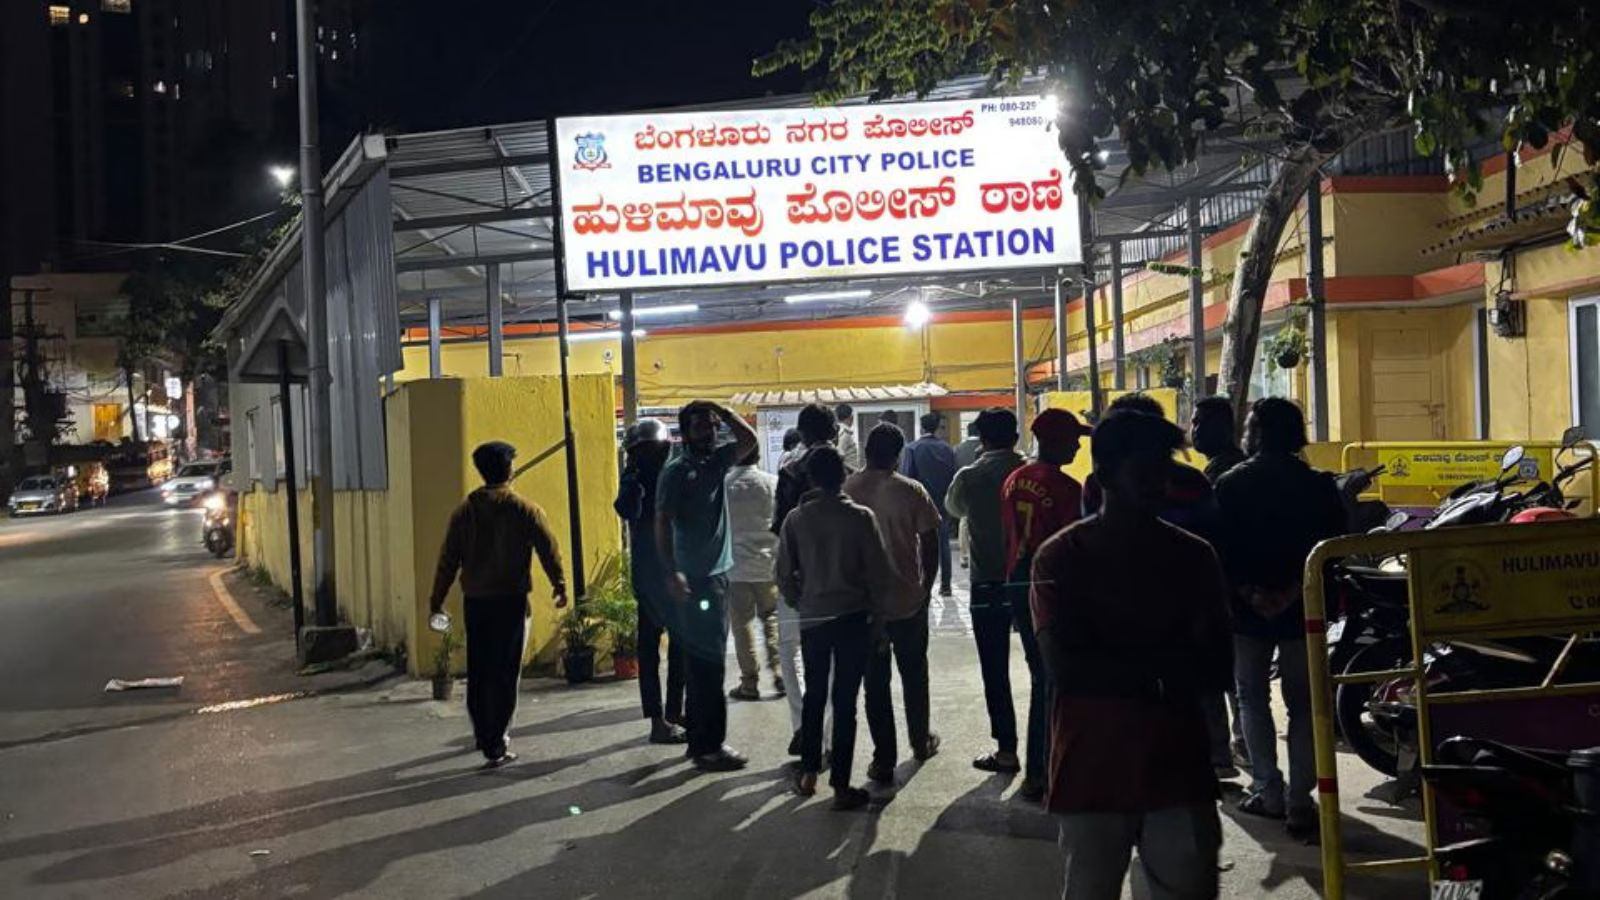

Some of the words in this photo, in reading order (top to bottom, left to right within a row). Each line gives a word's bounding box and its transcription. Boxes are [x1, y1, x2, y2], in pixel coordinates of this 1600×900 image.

[981, 103, 997, 113] PH:
[635, 124, 770, 149] ಬೆಂಗಳೂರು
[786, 119, 848, 142] ನಗರ
[864, 110, 974, 139] ಪೊಲೀಸ್
[638, 158, 801, 183] BENGALURU
[811, 153, 872, 175] CITY
[881, 149, 975, 171] POLICE
[572, 190, 763, 237] ಹುಳಿಮಾವು
[787, 176, 956, 224] ಪೊಲೀಸ್
[980, 169, 1063, 214] ಠಾಣೆ
[587, 243, 767, 278] HULIMAVU
[780, 236, 901, 268] POLICE
[912, 227, 1055, 262] STATION
[1502, 552, 1600, 572] HULIMAVU
